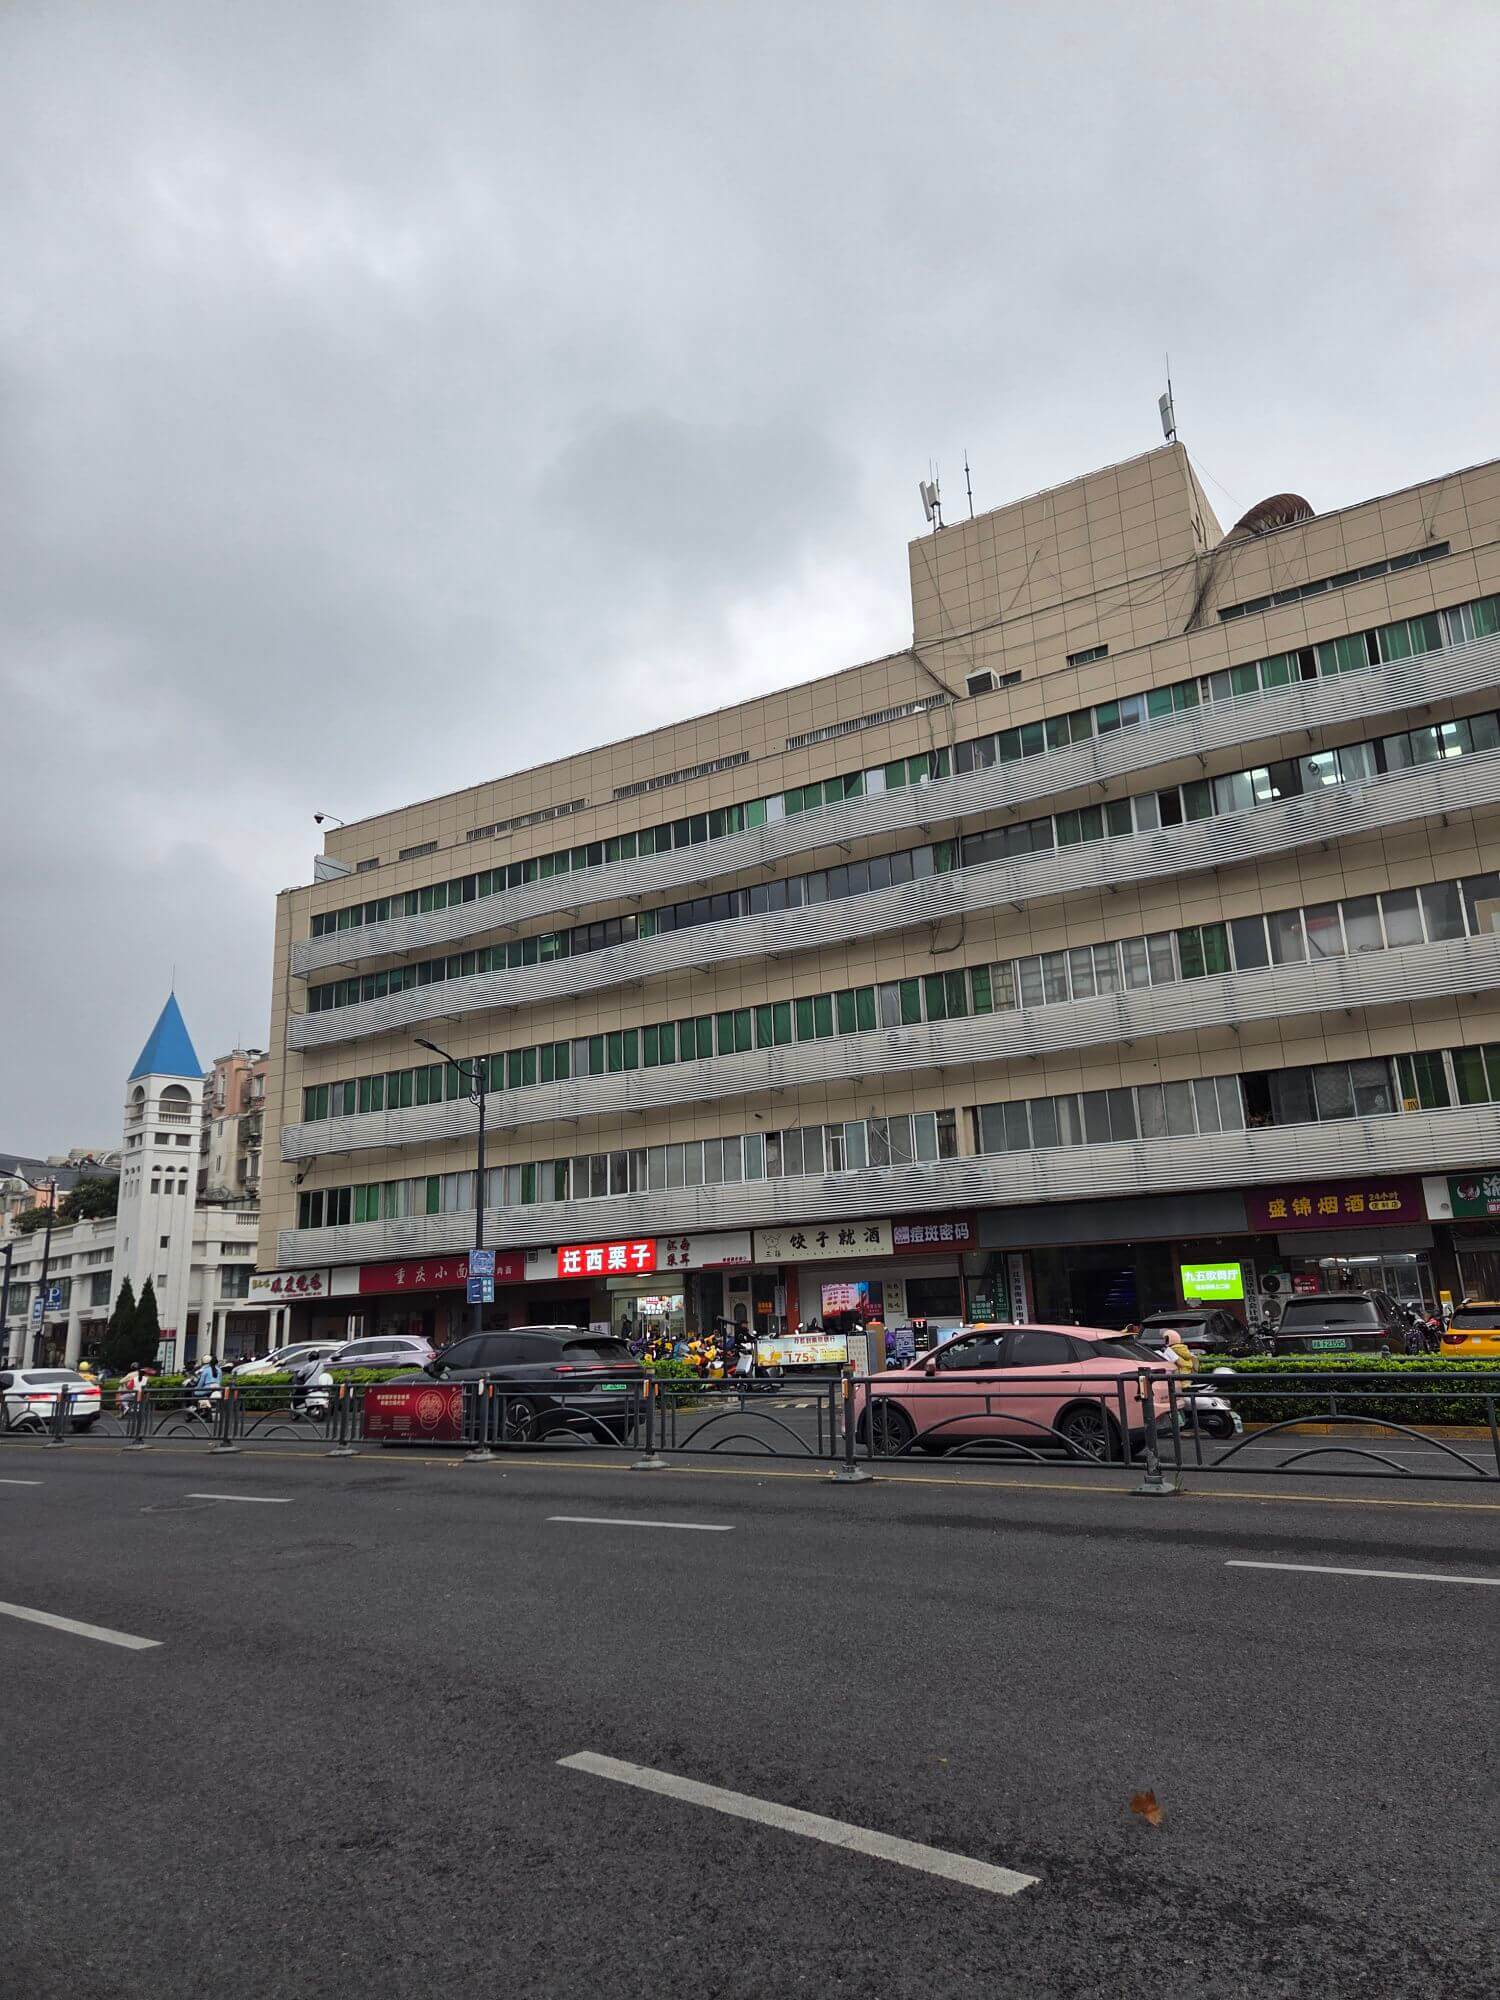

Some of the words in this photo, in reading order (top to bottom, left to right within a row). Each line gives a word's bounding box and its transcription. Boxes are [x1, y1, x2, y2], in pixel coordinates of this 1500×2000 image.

[1269, 1194, 1364, 1218] 盛锦烟酒
[1369, 1191, 1399, 1201] 24小时
[790, 1227, 880, 1249] 饺子就酒
[910, 1223, 969, 1243] 痘斑密码
[563, 1244, 650, 1273] 迁西栗子
[394, 1263, 467, 1284] 重庆小面
[48, 1287, 60, 1302] P
